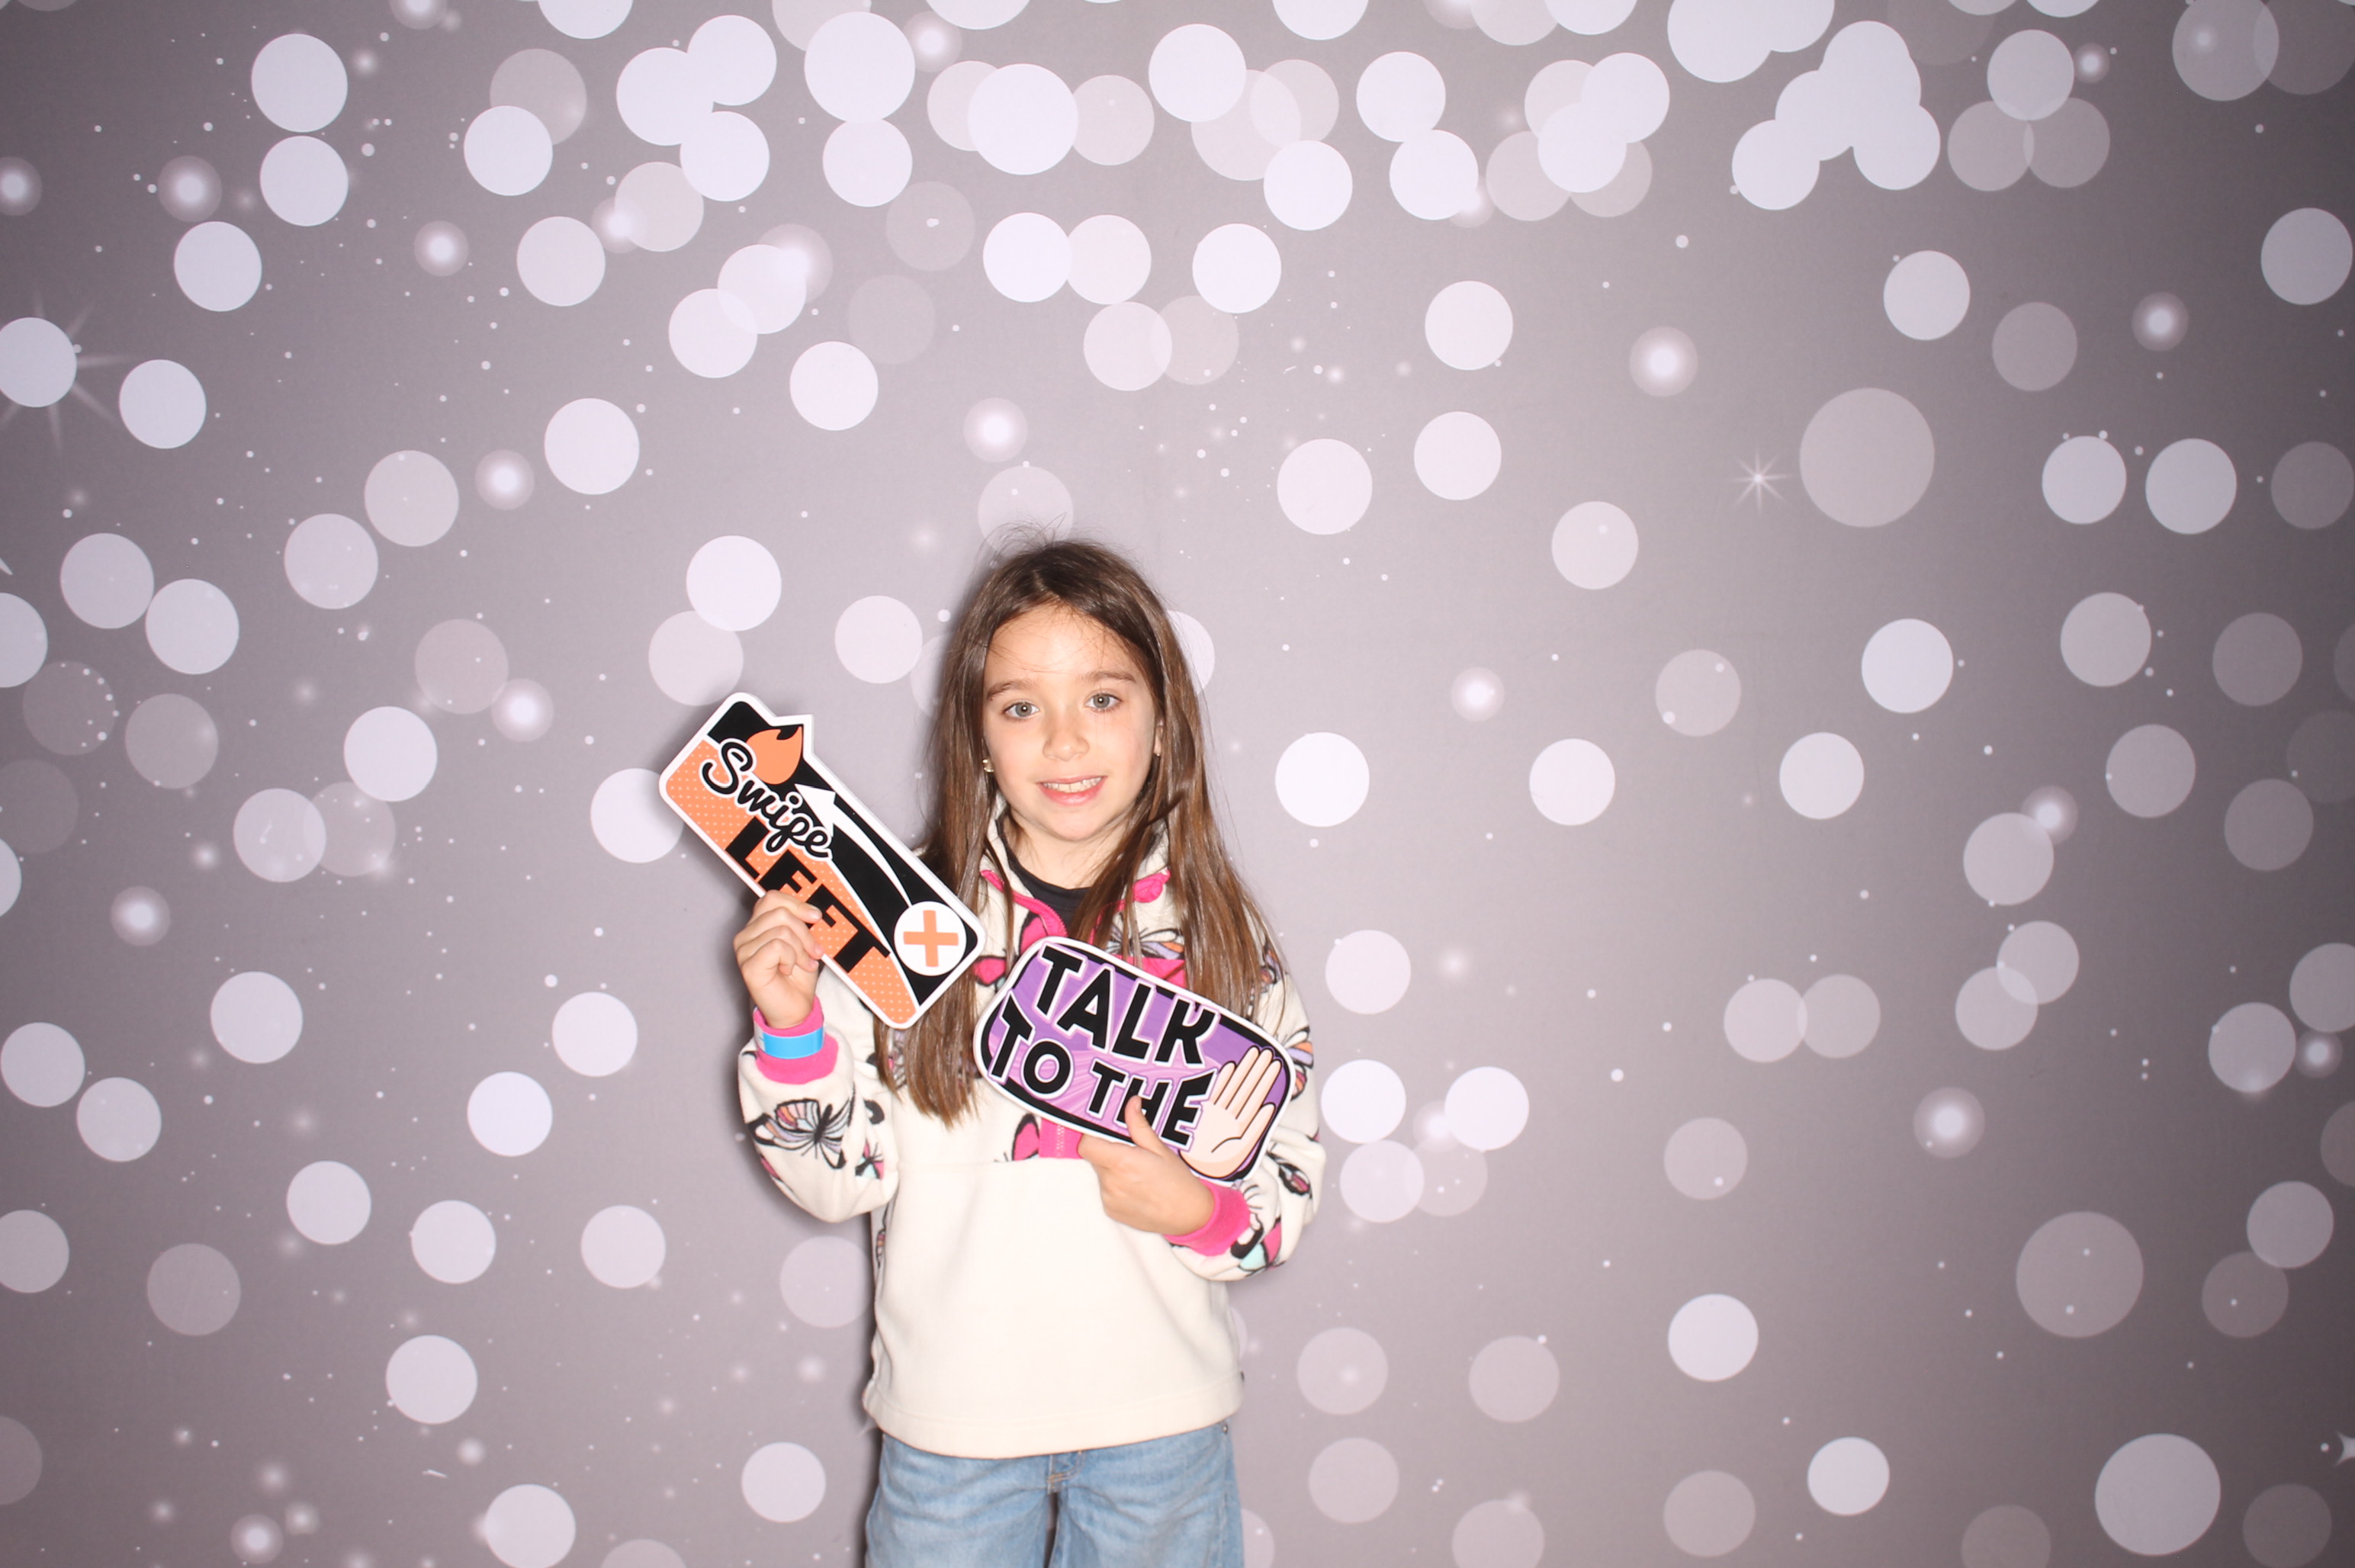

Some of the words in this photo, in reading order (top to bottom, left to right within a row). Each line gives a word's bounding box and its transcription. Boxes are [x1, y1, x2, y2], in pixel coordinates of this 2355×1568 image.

[702, 741, 830, 858] Swipe
[725, 816, 891, 973] LEFT
[991, 997, 1069, 1094] TO
[1088, 1061, 1216, 1146] THE
[1042, 945, 1216, 1064] TALK
